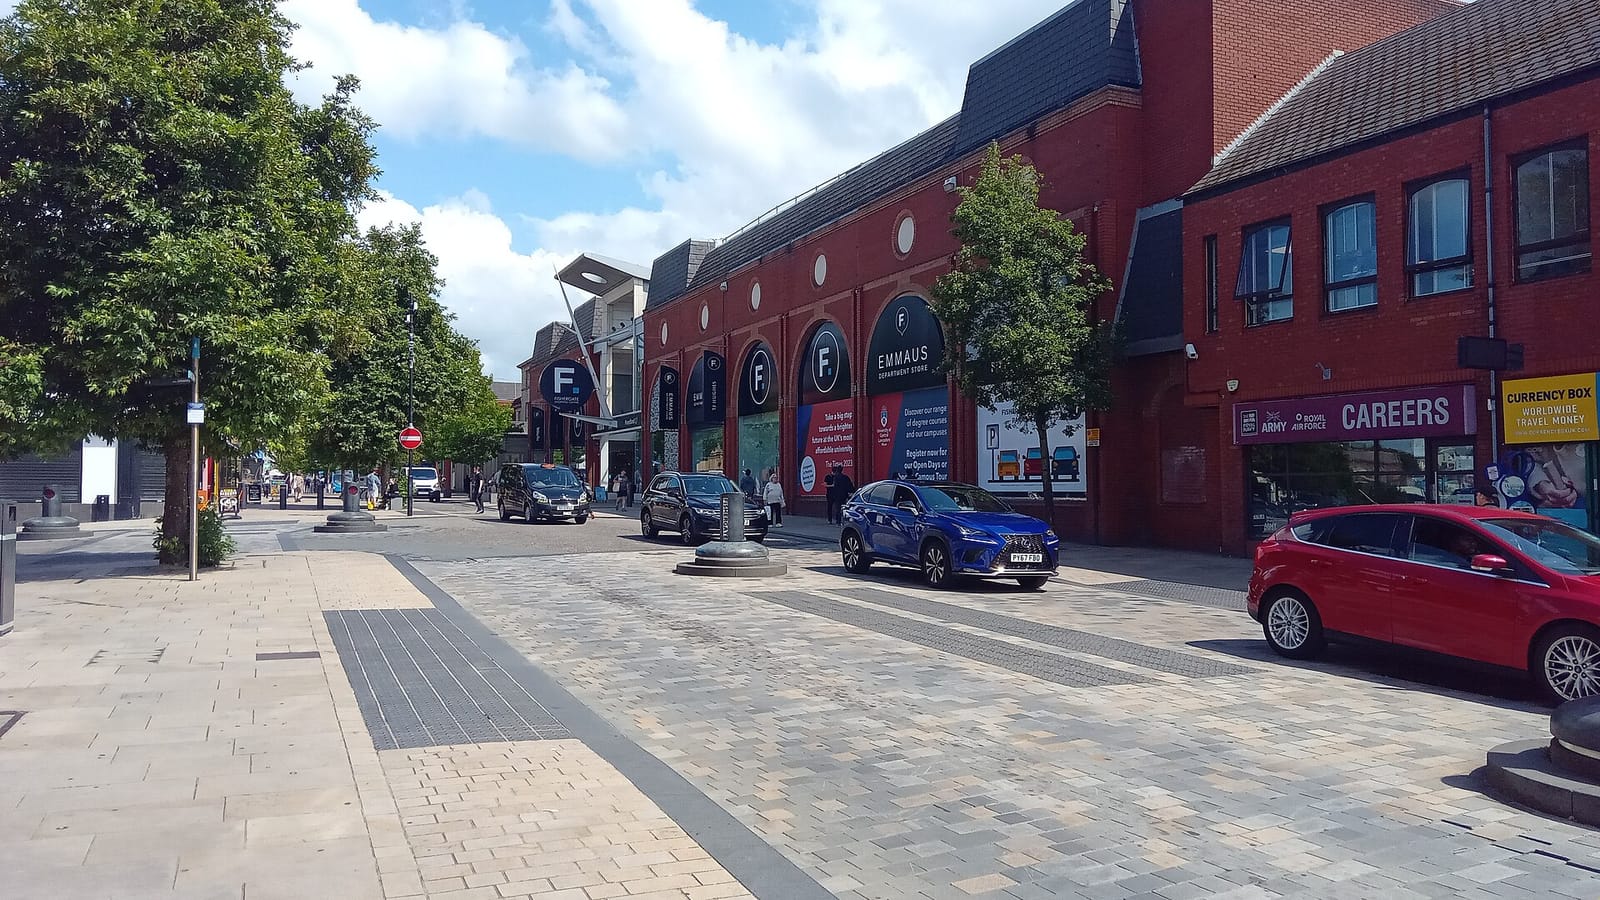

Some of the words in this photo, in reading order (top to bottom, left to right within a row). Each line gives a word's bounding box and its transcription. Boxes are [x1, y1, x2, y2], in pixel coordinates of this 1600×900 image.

[878, 345, 928, 369] EMMAUS
[878, 367, 910, 380] DEPARTMENT
[911, 364, 928, 374] STORE
[1507, 389, 1566, 403] CURRENCY
[1568, 387, 1592, 399] BOX
[904, 408, 923, 417] Discover
[932, 405, 947, 415] range
[1342, 397, 1449, 430] CAREERS
[1522, 404, 1577, 416] WORLDWIDE
[906, 418, 912, 427] of
[912, 418, 928, 428] degree
[929, 417, 947, 425] courses
[1303, 414, 1326, 423] ROYAL
[1516, 417, 1549, 428] TRAVEL
[1552, 414, 1585, 425] MONEY
[837, 422, 853, 432] brighter
[1261, 421, 1287, 433] ARMY
[1291, 423, 1304, 431] AIR
[1304, 421, 1326, 430] FORCE
[906, 429, 915, 438] and
[923, 429, 947, 439] campuses
[990, 428, 996, 446] P
[906, 449, 927, 459] Register
[939, 447, 947, 456] for
[904, 462, 913, 470] our
[913, 460, 927, 471] Open
[928, 460, 940, 470] Days
[936, 472, 947, 480] Tour
[1012, 554, 1028, 562] PY67
